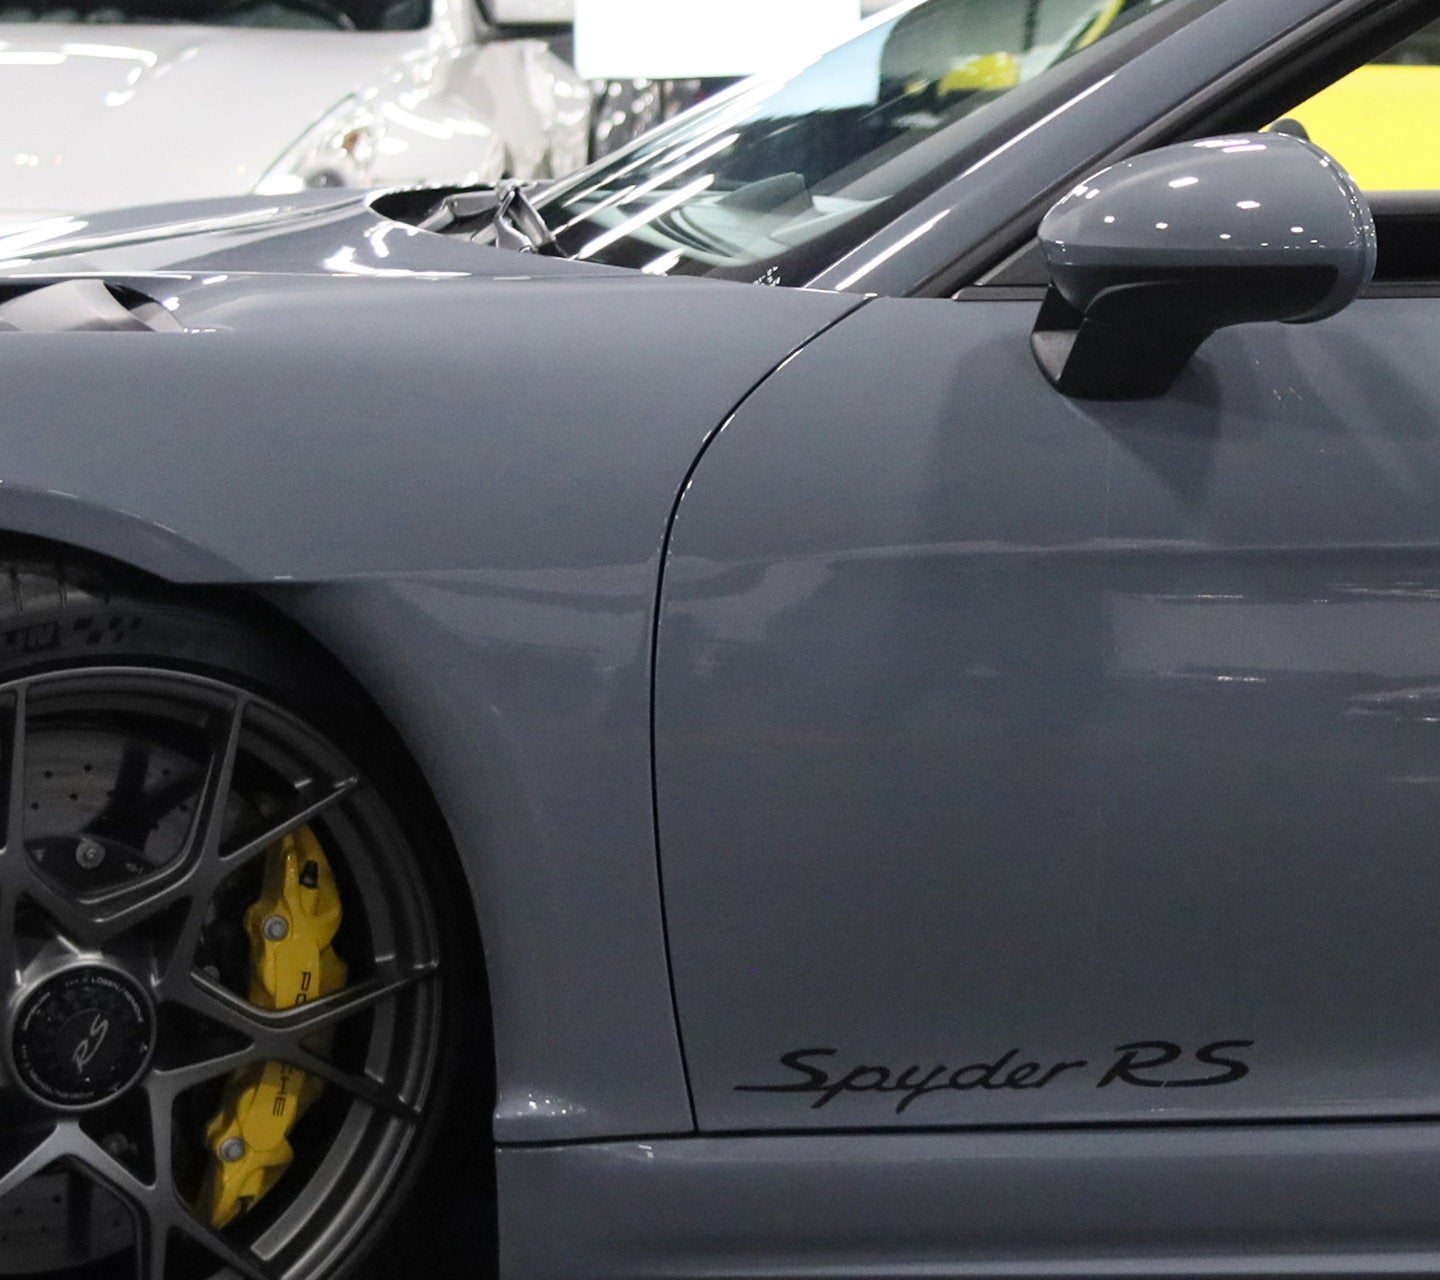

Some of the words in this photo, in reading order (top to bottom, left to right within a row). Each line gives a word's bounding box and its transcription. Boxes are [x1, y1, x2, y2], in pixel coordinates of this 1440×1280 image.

[71, 1013, 110, 1075] RS
[734, 1048, 1087, 1113] Spyder
[1096, 1040, 1255, 1088] RS
